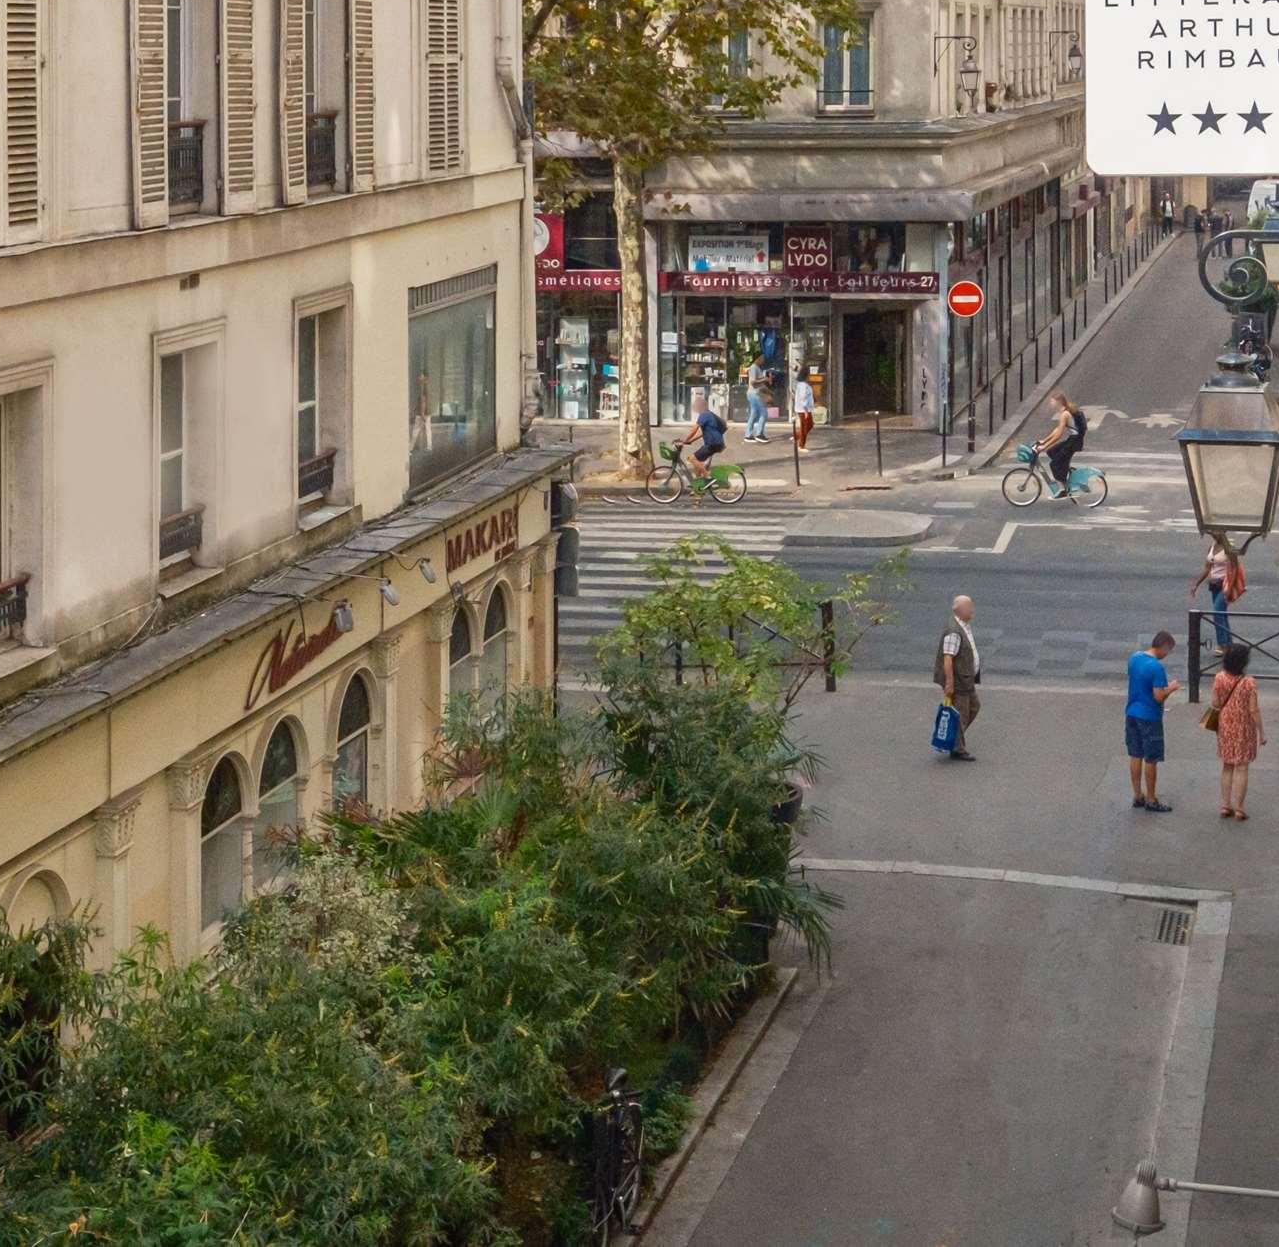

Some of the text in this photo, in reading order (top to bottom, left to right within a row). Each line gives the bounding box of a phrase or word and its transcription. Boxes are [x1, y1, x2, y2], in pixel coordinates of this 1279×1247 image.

[787, 237, 828, 250] CYRA
[787, 253, 828, 267] LYDO
[683, 275, 782, 287] Fournitures
[791, 277, 829, 288] pour
[447, 504, 519, 573] MAKARI
